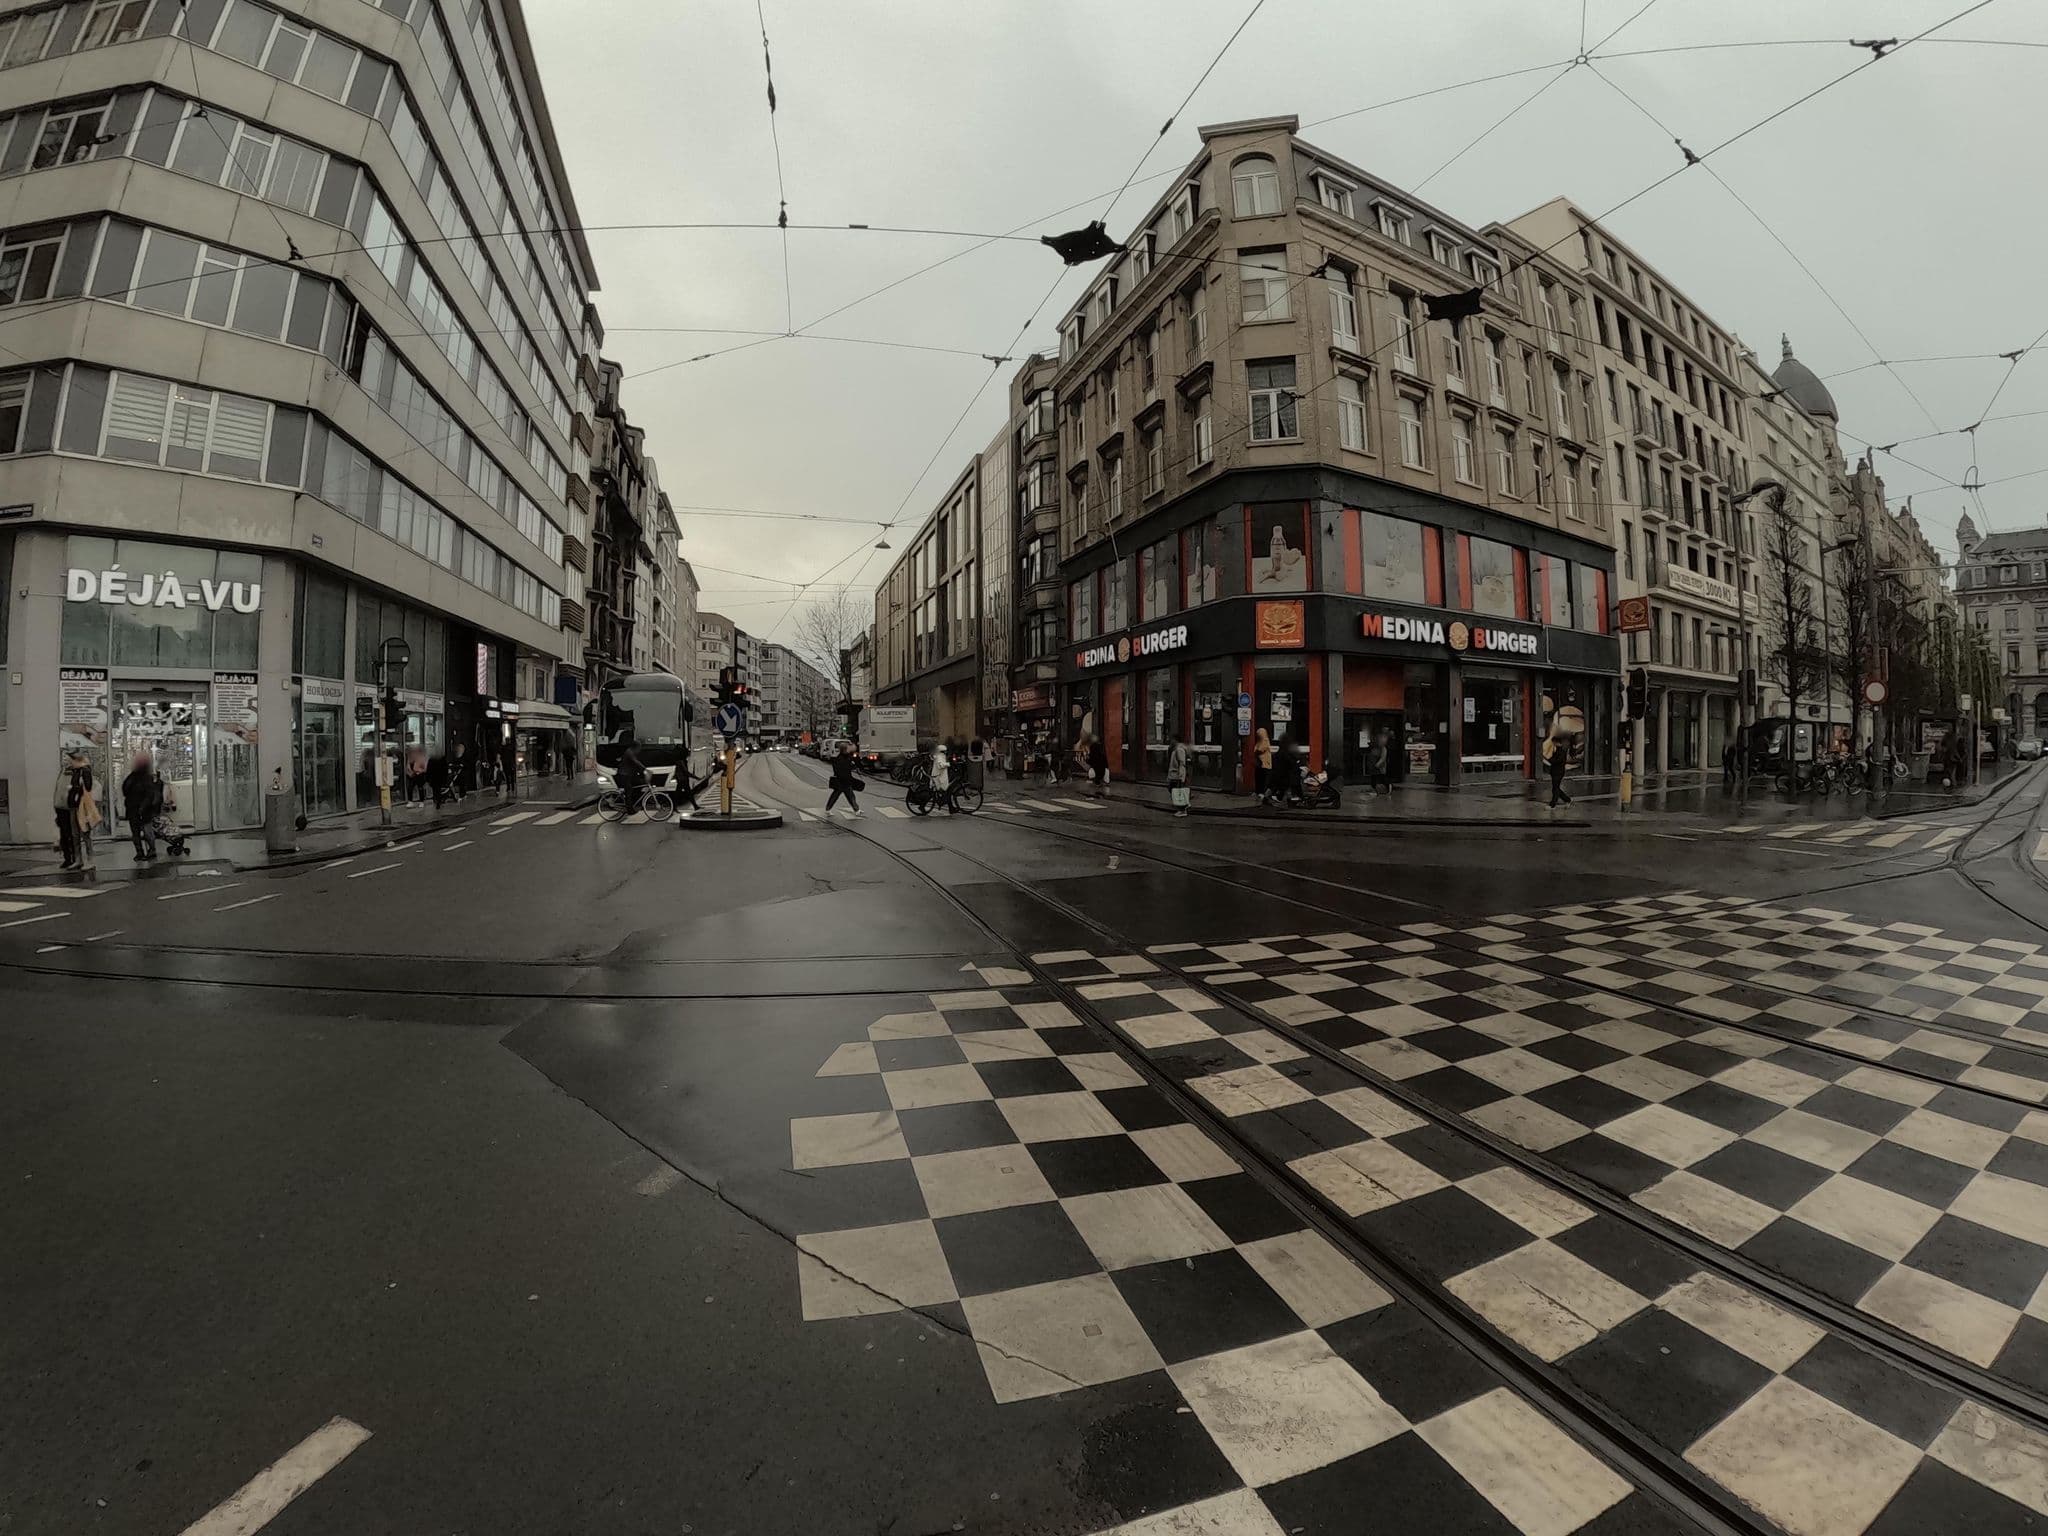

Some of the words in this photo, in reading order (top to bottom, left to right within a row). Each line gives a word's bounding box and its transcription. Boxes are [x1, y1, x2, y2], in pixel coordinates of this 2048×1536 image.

[1077, 644, 1115, 668] MEDINA
[1133, 625, 1187, 656] BURGER
[1363, 613, 1445, 644] MEDINA
[1474, 627, 1537, 654] BURGER
